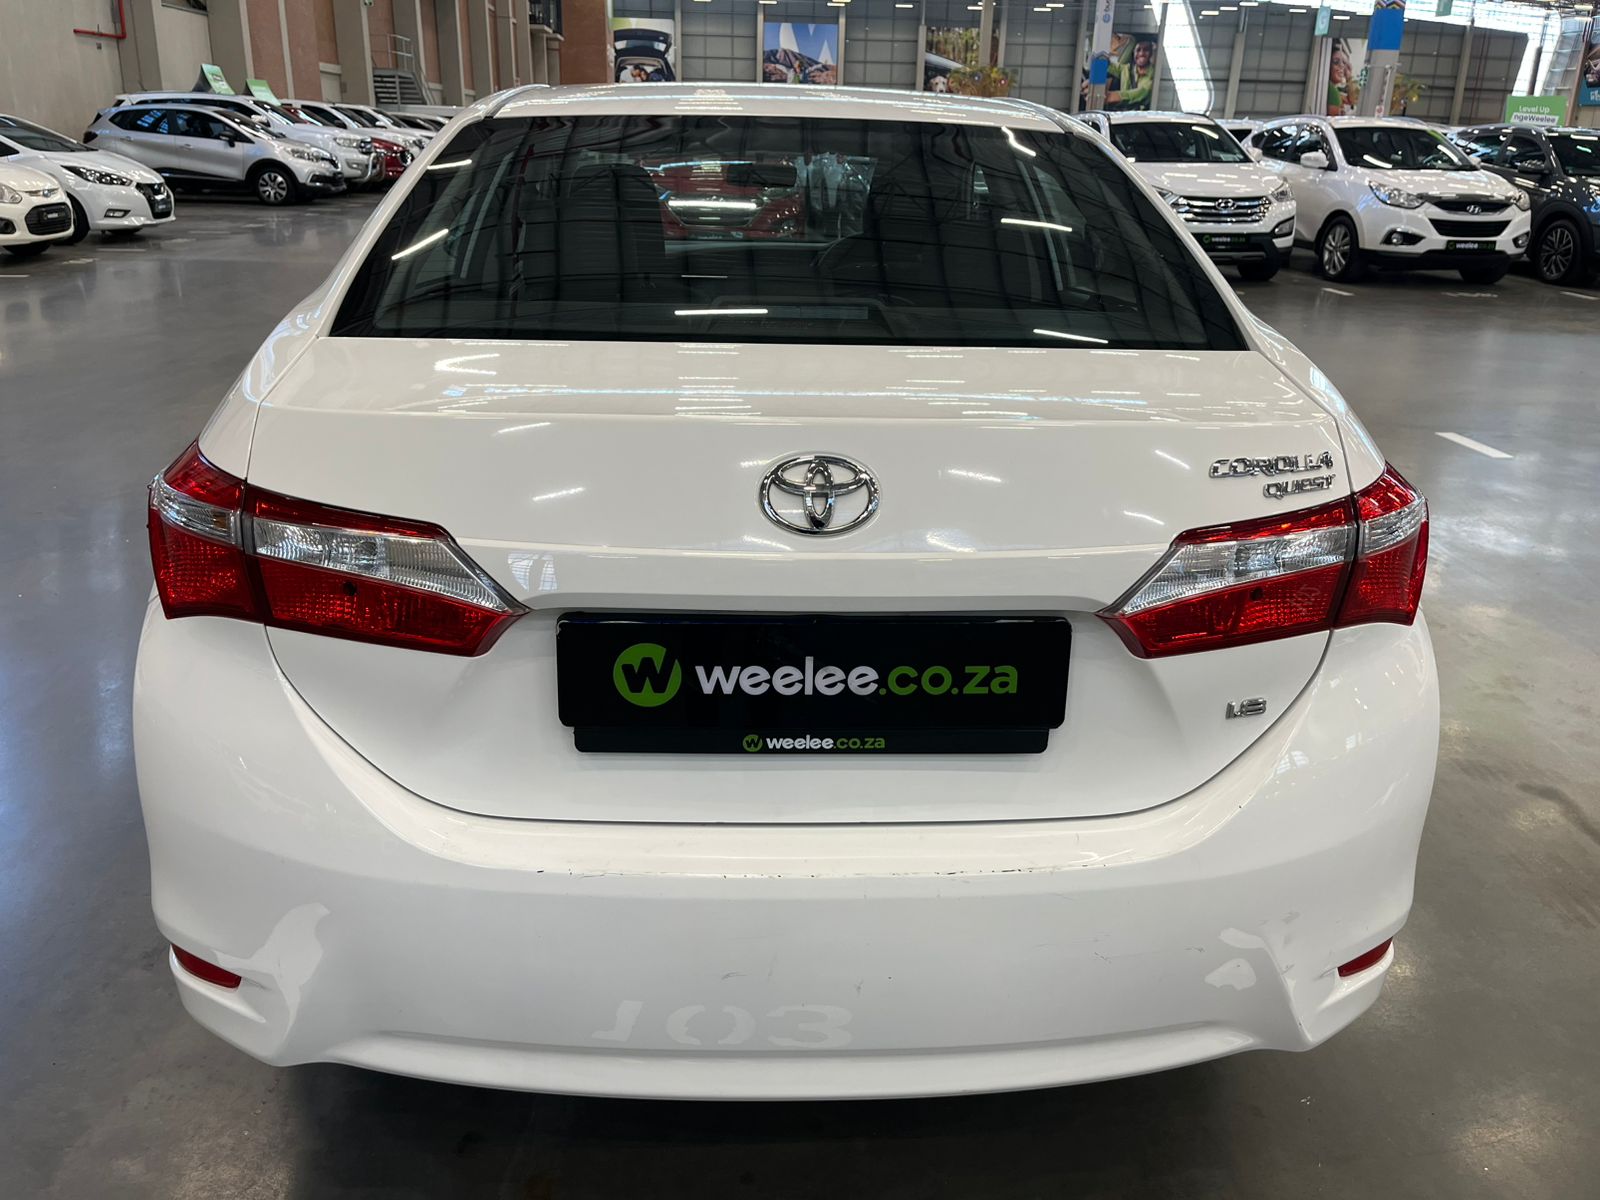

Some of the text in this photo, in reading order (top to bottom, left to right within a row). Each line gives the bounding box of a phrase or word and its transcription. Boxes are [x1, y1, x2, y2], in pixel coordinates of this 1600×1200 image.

[1519, 105, 1550, 114] Level Up
[1209, 451, 1333, 478] COROLLA
[1263, 474, 1336, 500] QUEST
[695, 656, 1018, 696] weelee.co.za
[766, 734, 886, 749] weelee.co.za
